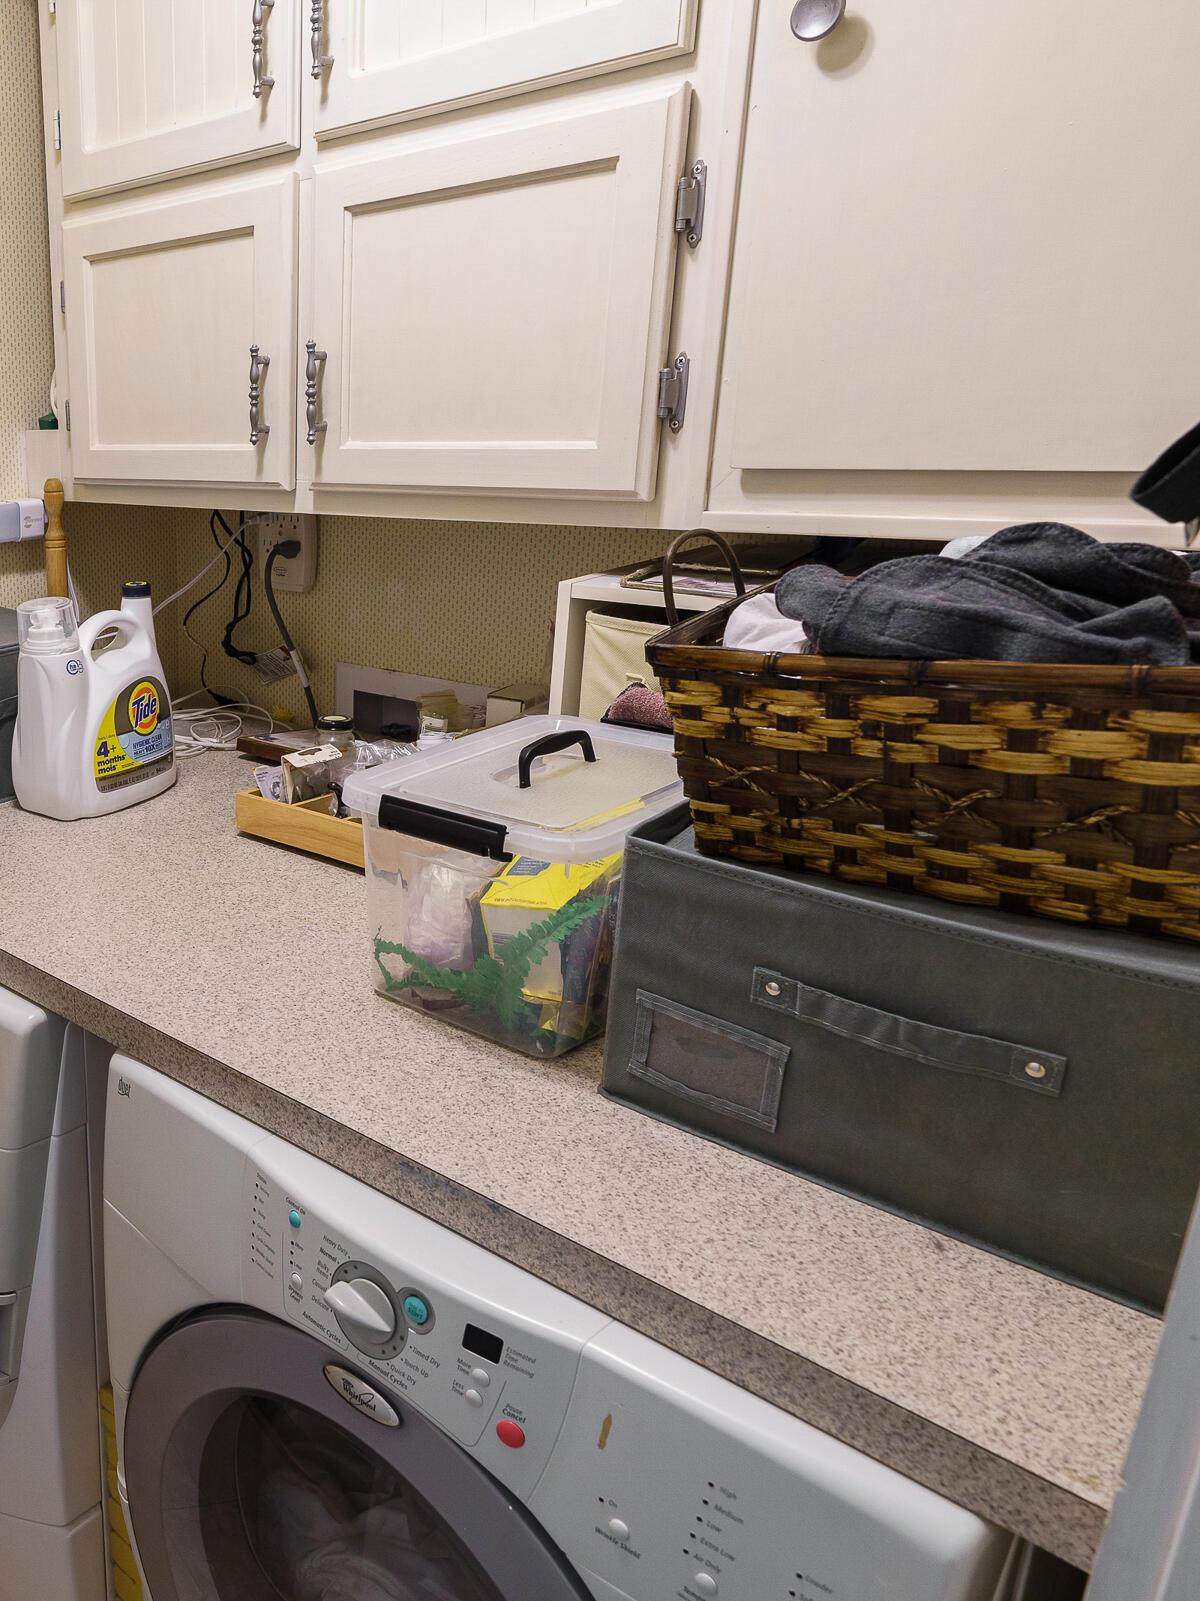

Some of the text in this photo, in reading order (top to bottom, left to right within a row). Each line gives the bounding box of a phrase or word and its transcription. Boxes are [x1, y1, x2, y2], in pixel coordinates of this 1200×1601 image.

[131, 694, 157, 729] Tide
[97, 741, 116, 757] 4+
[145, 743, 155, 753] 10X
[117, 1076, 131, 1098] duet
[319, 1247, 337, 1263] Normal
[323, 1235, 348, 1256] Heavy Duty
[302, 1311, 342, 1344] Automatic Cycles
[412, 1347, 441, 1368] Timed Dry
[506, 1346, 537, 1364] Estimated
[368, 1360, 408, 1390] Manual Cycles
[390, 1363, 417, 1386] Quick Dry
[420, 1367, 429, 1379] Up
[342, 1379, 376, 1412] Whirlpool
[502, 1408, 526, 1424] Cancel
